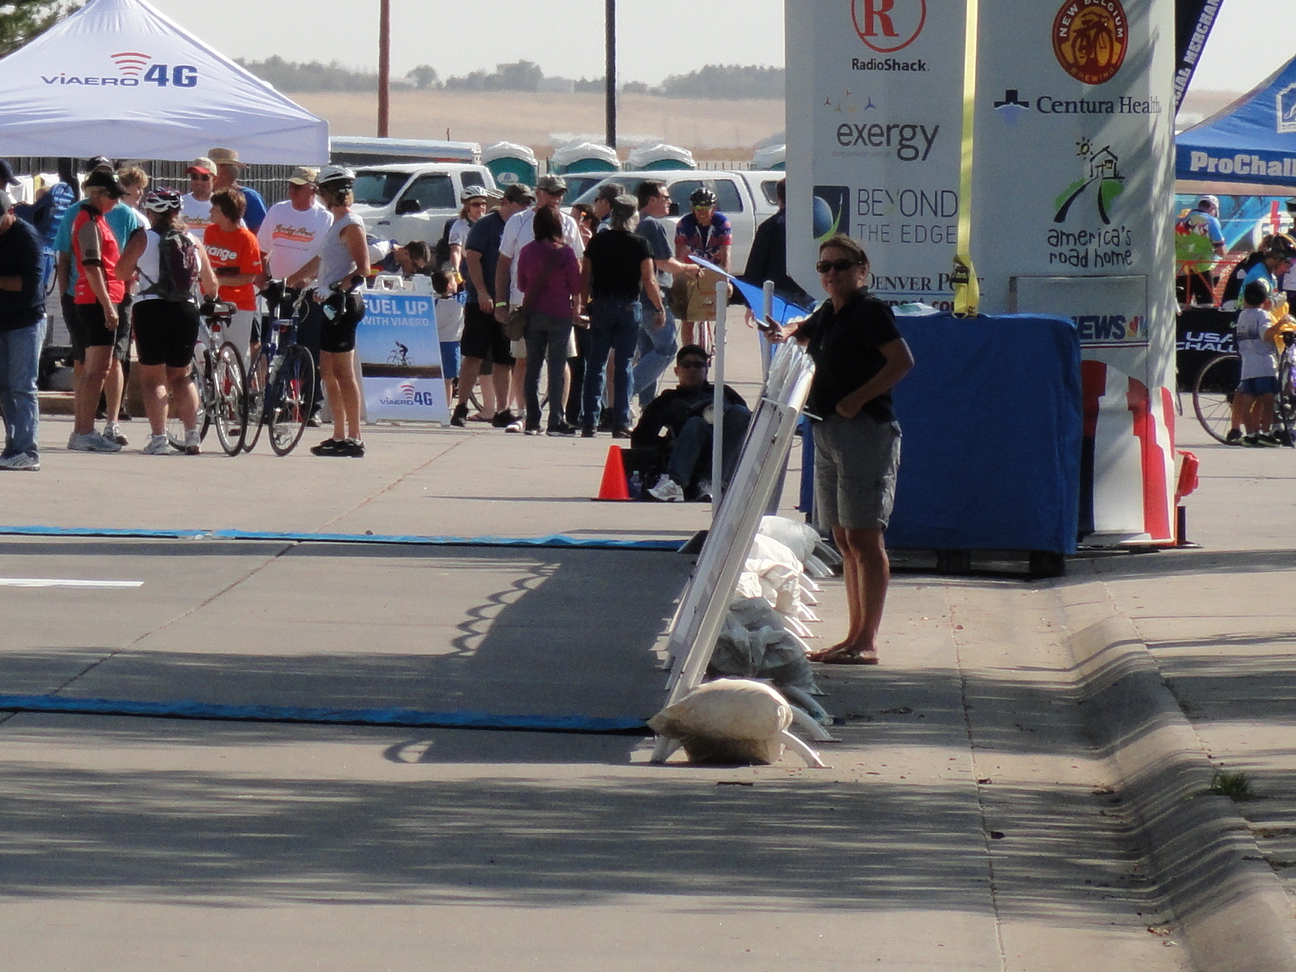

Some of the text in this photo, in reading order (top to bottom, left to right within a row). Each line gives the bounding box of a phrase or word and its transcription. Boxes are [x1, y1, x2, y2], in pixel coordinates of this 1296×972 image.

[1059, 3, 1079, 37] NEW
[851, 58, 927, 72] RadioShack
[1070, 67, 1115, 82] BREWING
[143, 64, 198, 88] 4G
[1036, 95, 1115, 115] Centura
[836, 122, 940, 162] exergy
[857, 188, 958, 218] BEYOND
[858, 224, 957, 244] THE EDGE
[1047, 228, 1133, 247] america's
[1049, 247, 1133, 267] road home
[363, 299, 429, 315] FUEL UP
[362, 317, 430, 327] WITH VIAERO
[414, 391, 433, 406] 4G
